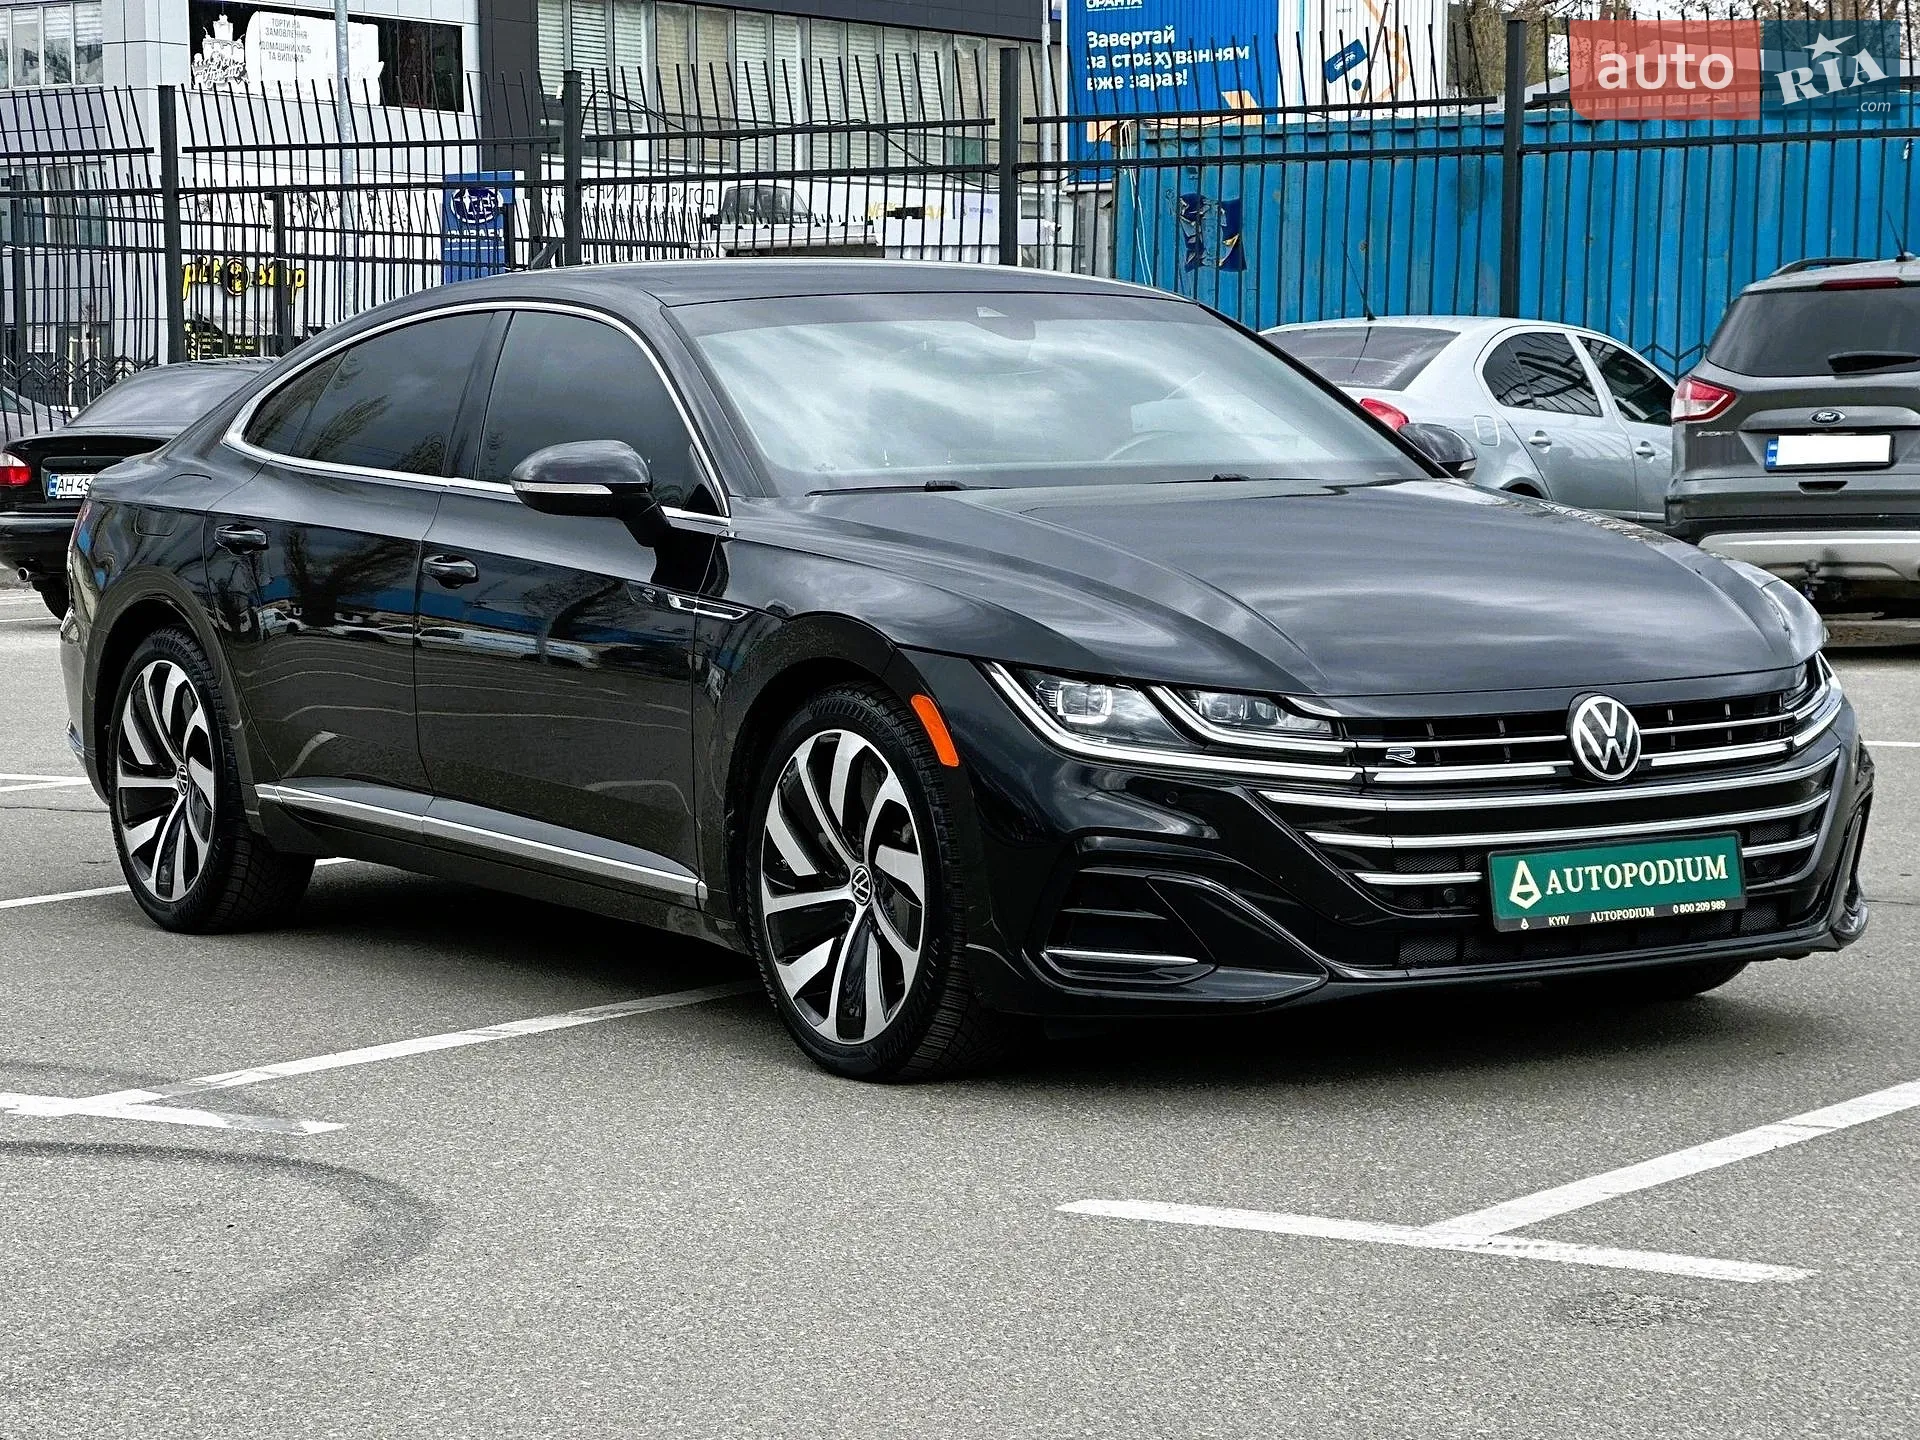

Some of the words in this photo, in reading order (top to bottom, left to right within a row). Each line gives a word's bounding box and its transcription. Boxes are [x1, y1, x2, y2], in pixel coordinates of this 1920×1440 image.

[265, 27, 308, 39] ЗАМОВЛЕННЯ
[271, 18, 291, 28] ТОРТИ
[1086, 25, 1175, 49] Завертай
[269, 51, 277, 60] ТА
[277, 52, 305, 63] ВИПІЧКА
[1111, 46, 1250, 70] страхуванням
[1086, 75, 1125, 91] вже
[1129, 69, 1188, 91] зараз!
[57, 478, 75, 492] AH
[1545, 855, 1729, 895] AUTOPODIUM
[1548, 915, 1570, 927] KYIV
[1590, 906, 1655, 923] AUTOPODIUM
[1673, 904, 1679, 915] 0
[1679, 902, 1695, 913] 800
[1695, 900, 1711, 912] 209
[1711, 899, 1726, 910] 989
